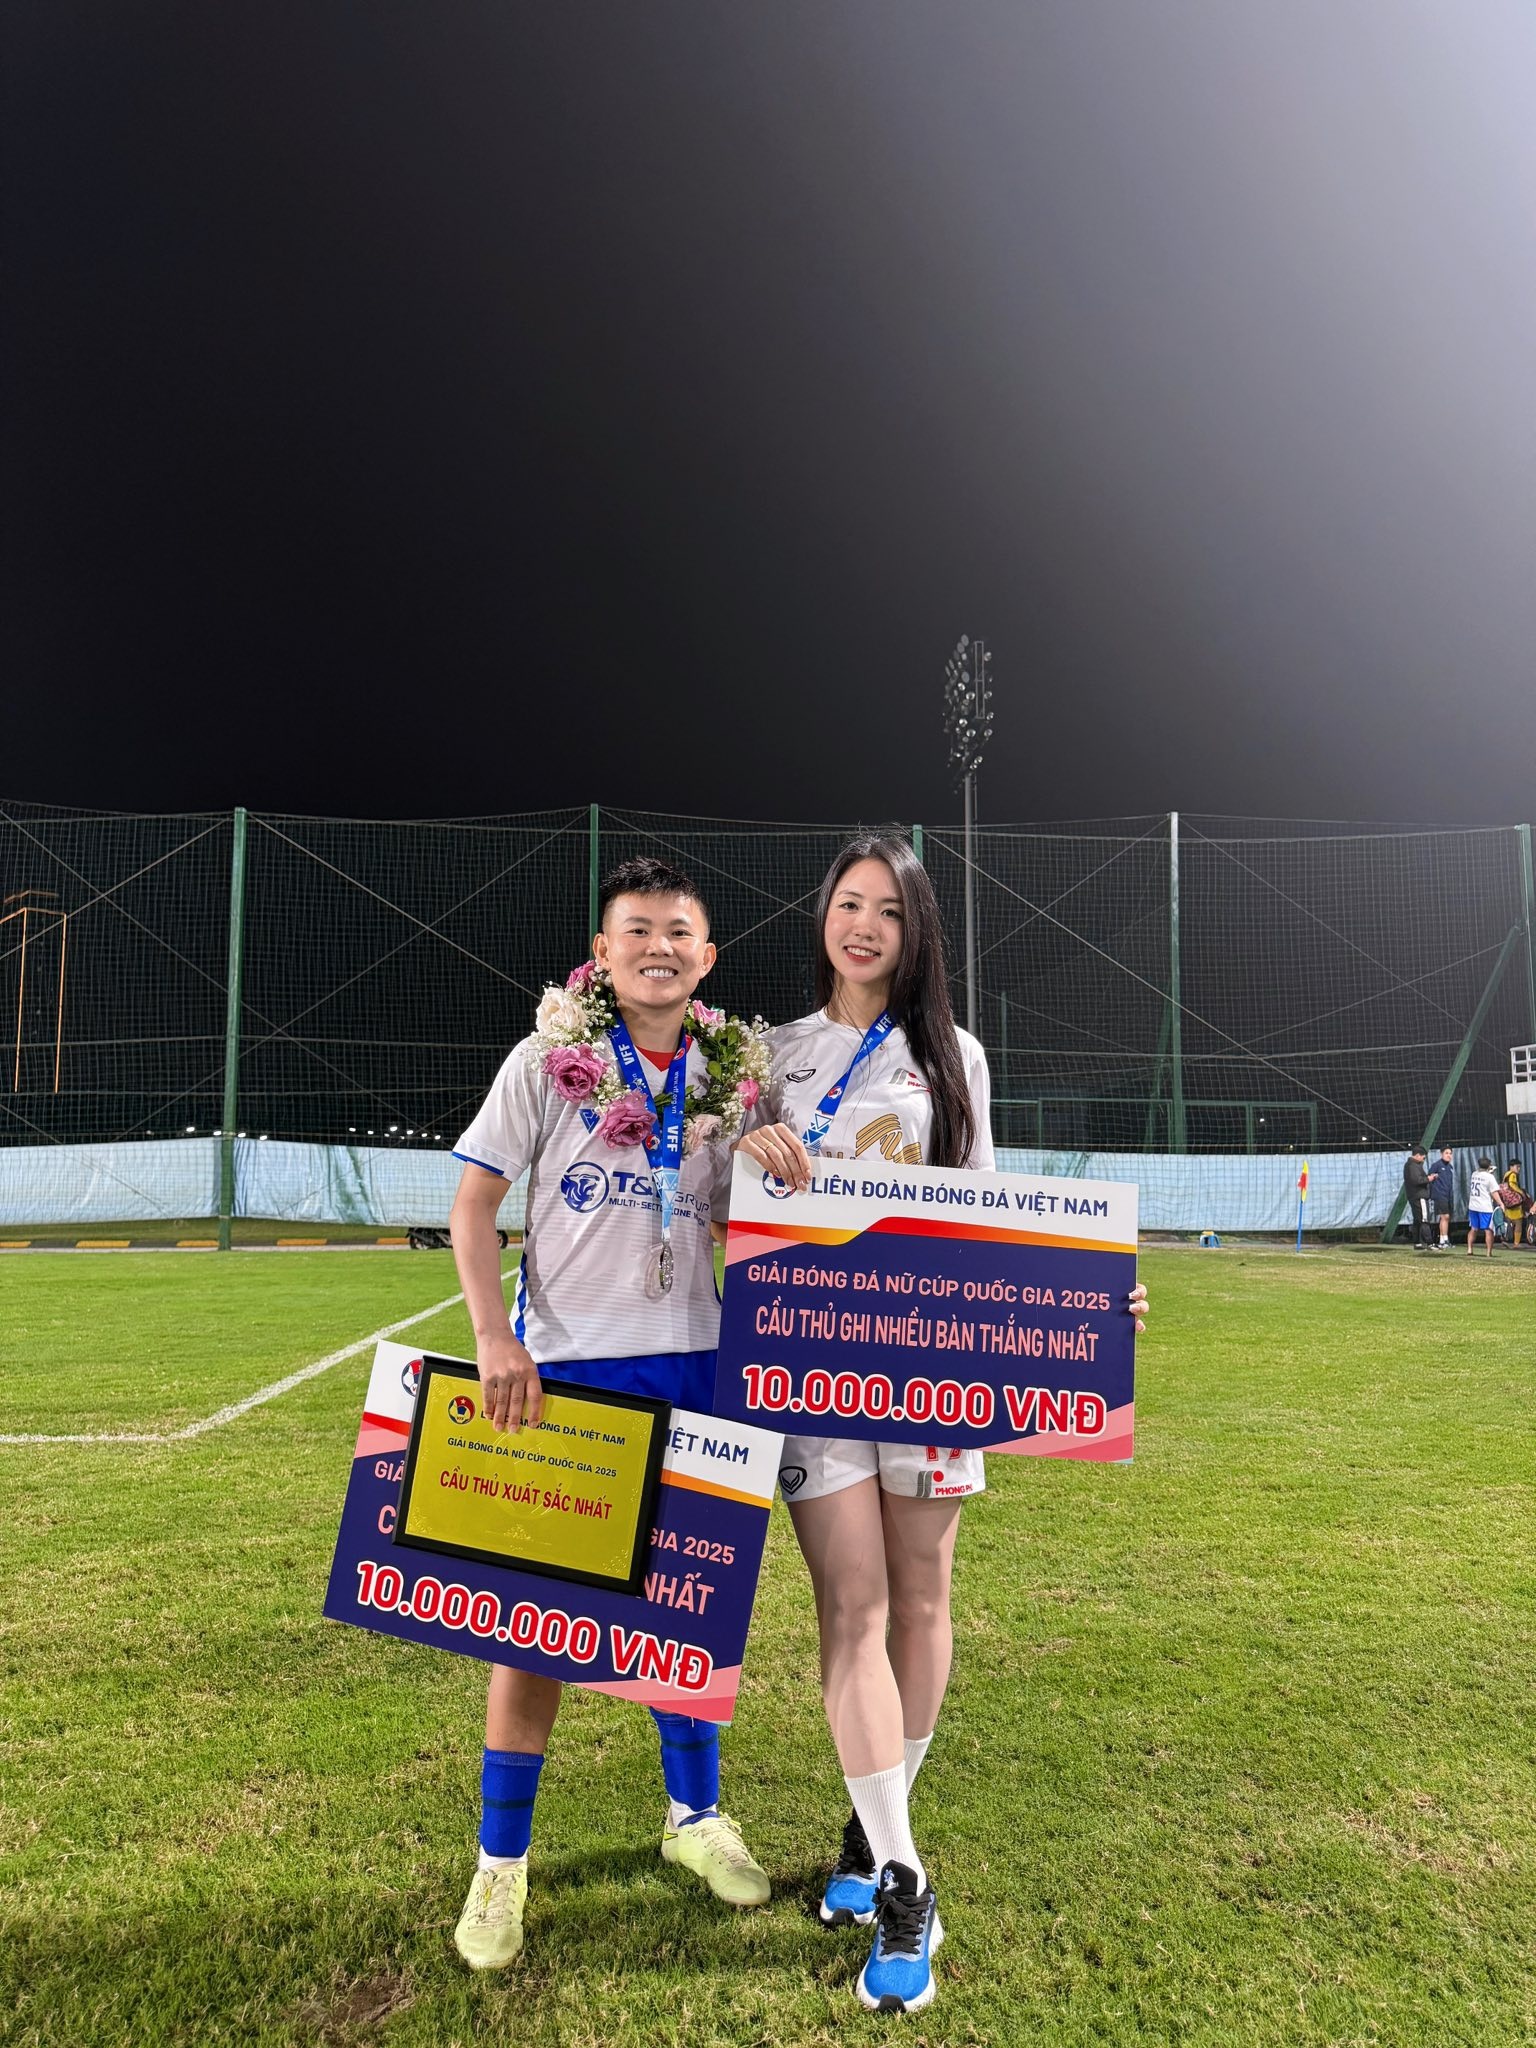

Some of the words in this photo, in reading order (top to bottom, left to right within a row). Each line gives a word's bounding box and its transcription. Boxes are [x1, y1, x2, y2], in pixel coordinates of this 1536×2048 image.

[618, 1043, 635, 1066] VFF
[666, 1125, 679, 1152] VFF
[811, 1174, 856, 1197] LIÊN
[861, 1178, 917, 1204] ĐOÀN
[921, 1184, 976, 1207] BÓNG
[982, 1187, 1010, 1209] ĐÁ
[1014, 1189, 1059, 1217] VIỆT
[1063, 1199, 1109, 1218] NAM
[747, 1261, 787, 1284] GIẢI
[792, 1266, 847, 1289] BÓNG
[853, 1268, 879, 1292] ĐÁ
[885, 1271, 915, 1296] NỮ
[919, 1272, 959, 1298] CÚP
[963, 1278, 1017, 1303] QUỐC
[1022, 1288, 1056, 1306] GIA
[1061, 1290, 1111, 1312] 2025
[755, 1296, 795, 1338] CẦU
[798, 1302, 836, 1340] THỦ
[840, 1313, 870, 1344] GHI
[875, 1306, 931, 1349] NHIỀU
[936, 1316, 974, 1352] BÀN
[980, 1315, 1044, 1358] THẮNG
[1048, 1322, 1099, 1362] NHẤT
[742, 1363, 994, 1429] 10.000.000
[1003, 1385, 1107, 1437] VNĐ
[536, 1419, 560, 1434] ÓNG
[562, 1423, 577, 1437] ĐÁ
[580, 1429, 600, 1442] VIỆT
[602, 1433, 626, 1446] NAM
[665, 1427, 699, 1454] IỆT
[701, 1437, 750, 1465] NAM
[374, 1459, 405, 1482] GIẢ
[447, 1436, 466, 1448] GIẢI
[468, 1440, 493, 1453] BÓNG
[495, 1444, 509, 1456] ĐÁ
[511, 1447, 526, 1460] NỮ
[527, 1450, 546, 1463] CÚP
[548, 1456, 574, 1469] QUỐC
[576, 1462, 592, 1473] GIA
[595, 1466, 617, 1477] 2025
[440, 1465, 469, 1491] CẦU
[472, 1472, 499, 1497] THỦ
[501, 1480, 541, 1506] XUẤT
[542, 1482, 571, 1512] SẮC
[573, 1495, 612, 1520] NHẤT
[935, 1485, 966, 1496] PHONG
[683, 1536, 736, 1565] 2025
[644, 1571, 715, 1616] NHẤT
[355, 1560, 600, 1665] 10.000.000
[610, 1624, 715, 1694] VNĐ
